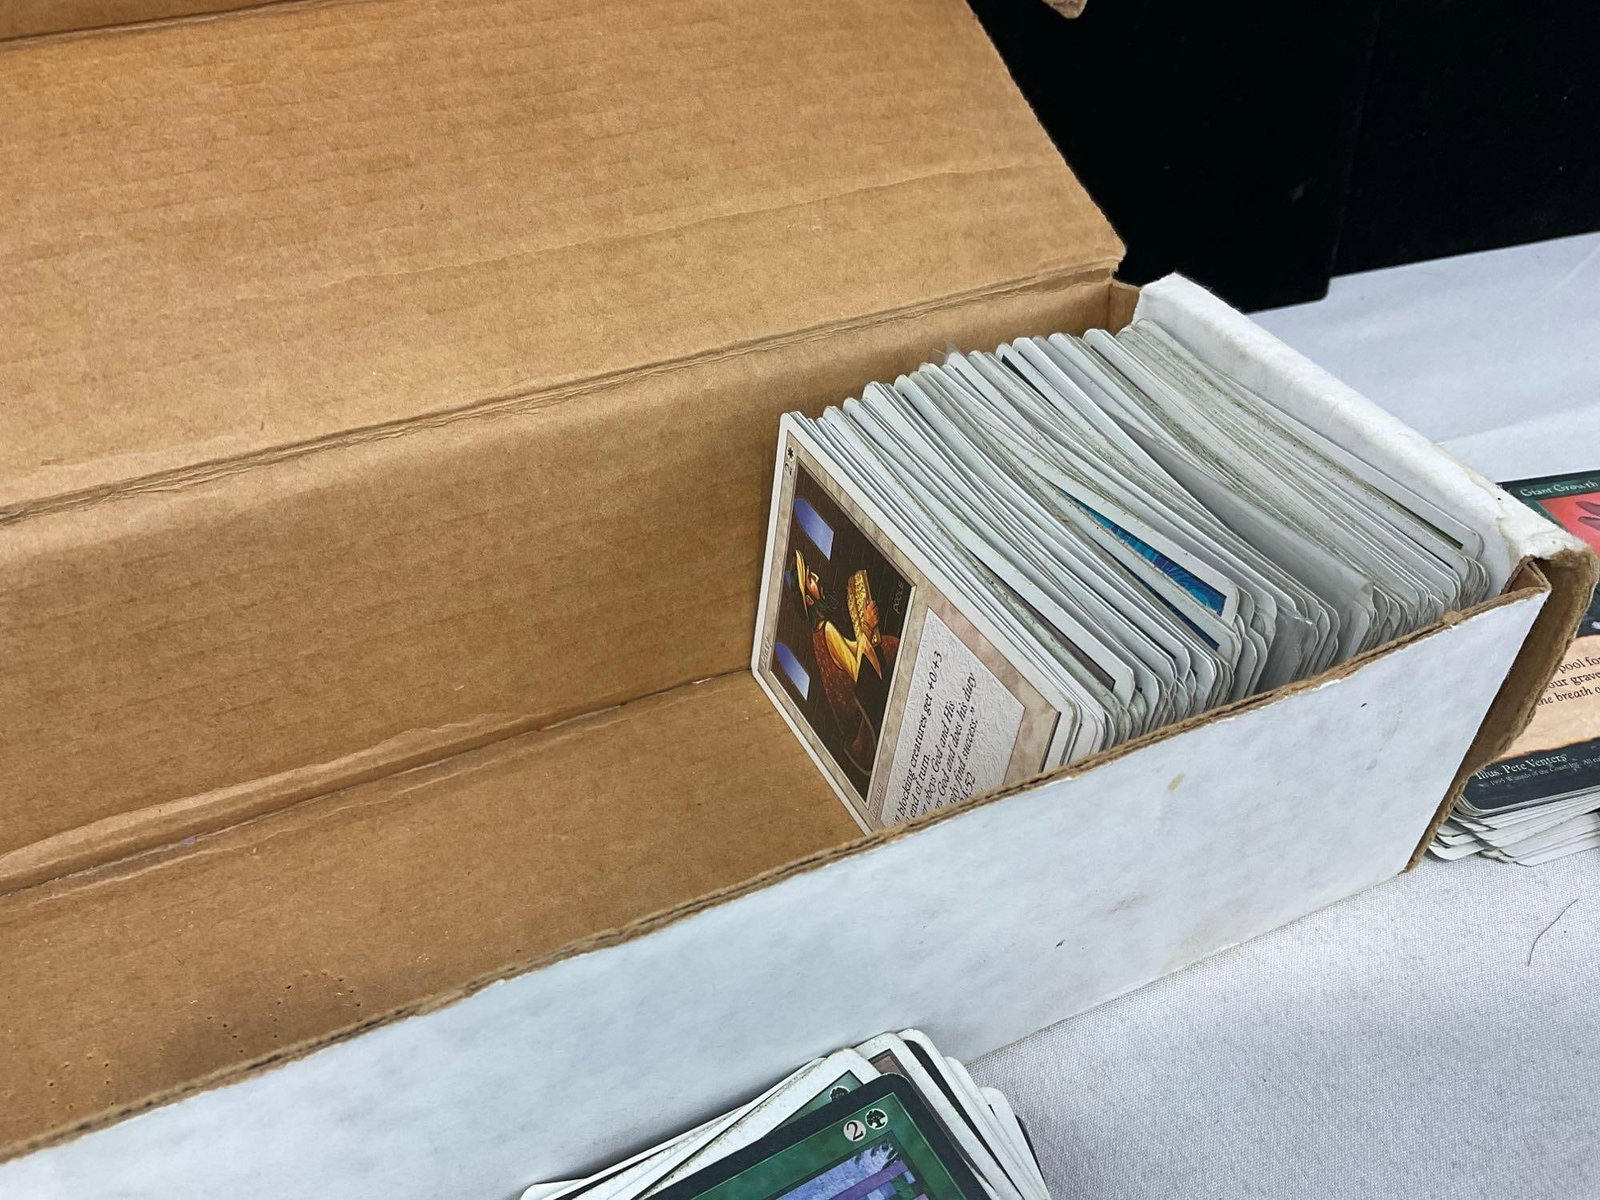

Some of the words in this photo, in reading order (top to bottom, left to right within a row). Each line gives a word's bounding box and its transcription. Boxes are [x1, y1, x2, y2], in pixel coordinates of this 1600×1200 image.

[1520, 488, 1552, 497] Giant
[1553, 480, 1599, 492] Growth
[927, 650, 943, 691] +0/+3
[1559, 659, 1585, 674] pool
[962, 672, 977, 703] duty
[1547, 679, 1569, 689] our
[1553, 686, 1593, 702] breath
[923, 693, 933, 717] get
[943, 700, 956, 724] His
[956, 701, 969, 722] his
[910, 714, 928, 768] creatures
[940, 719, 950, 748] and
[950, 721, 963, 748] does
[931, 745, 944, 773] God
[945, 744, 956, 773] and
[953, 755, 966, 790] find
[1475, 768, 1503, 780] Illus.
[1502, 763, 1527, 774] Pete
[1526, 753, 1568, 768] Venters
[896, 768, 917, 817] blocking
[910, 793, 920, 818] end
[918, 754, 931, 781] turn.
[924, 774, 937, 805] obeys
[937, 768, 951, 797] God
[846, 1121, 864, 1140] 2
